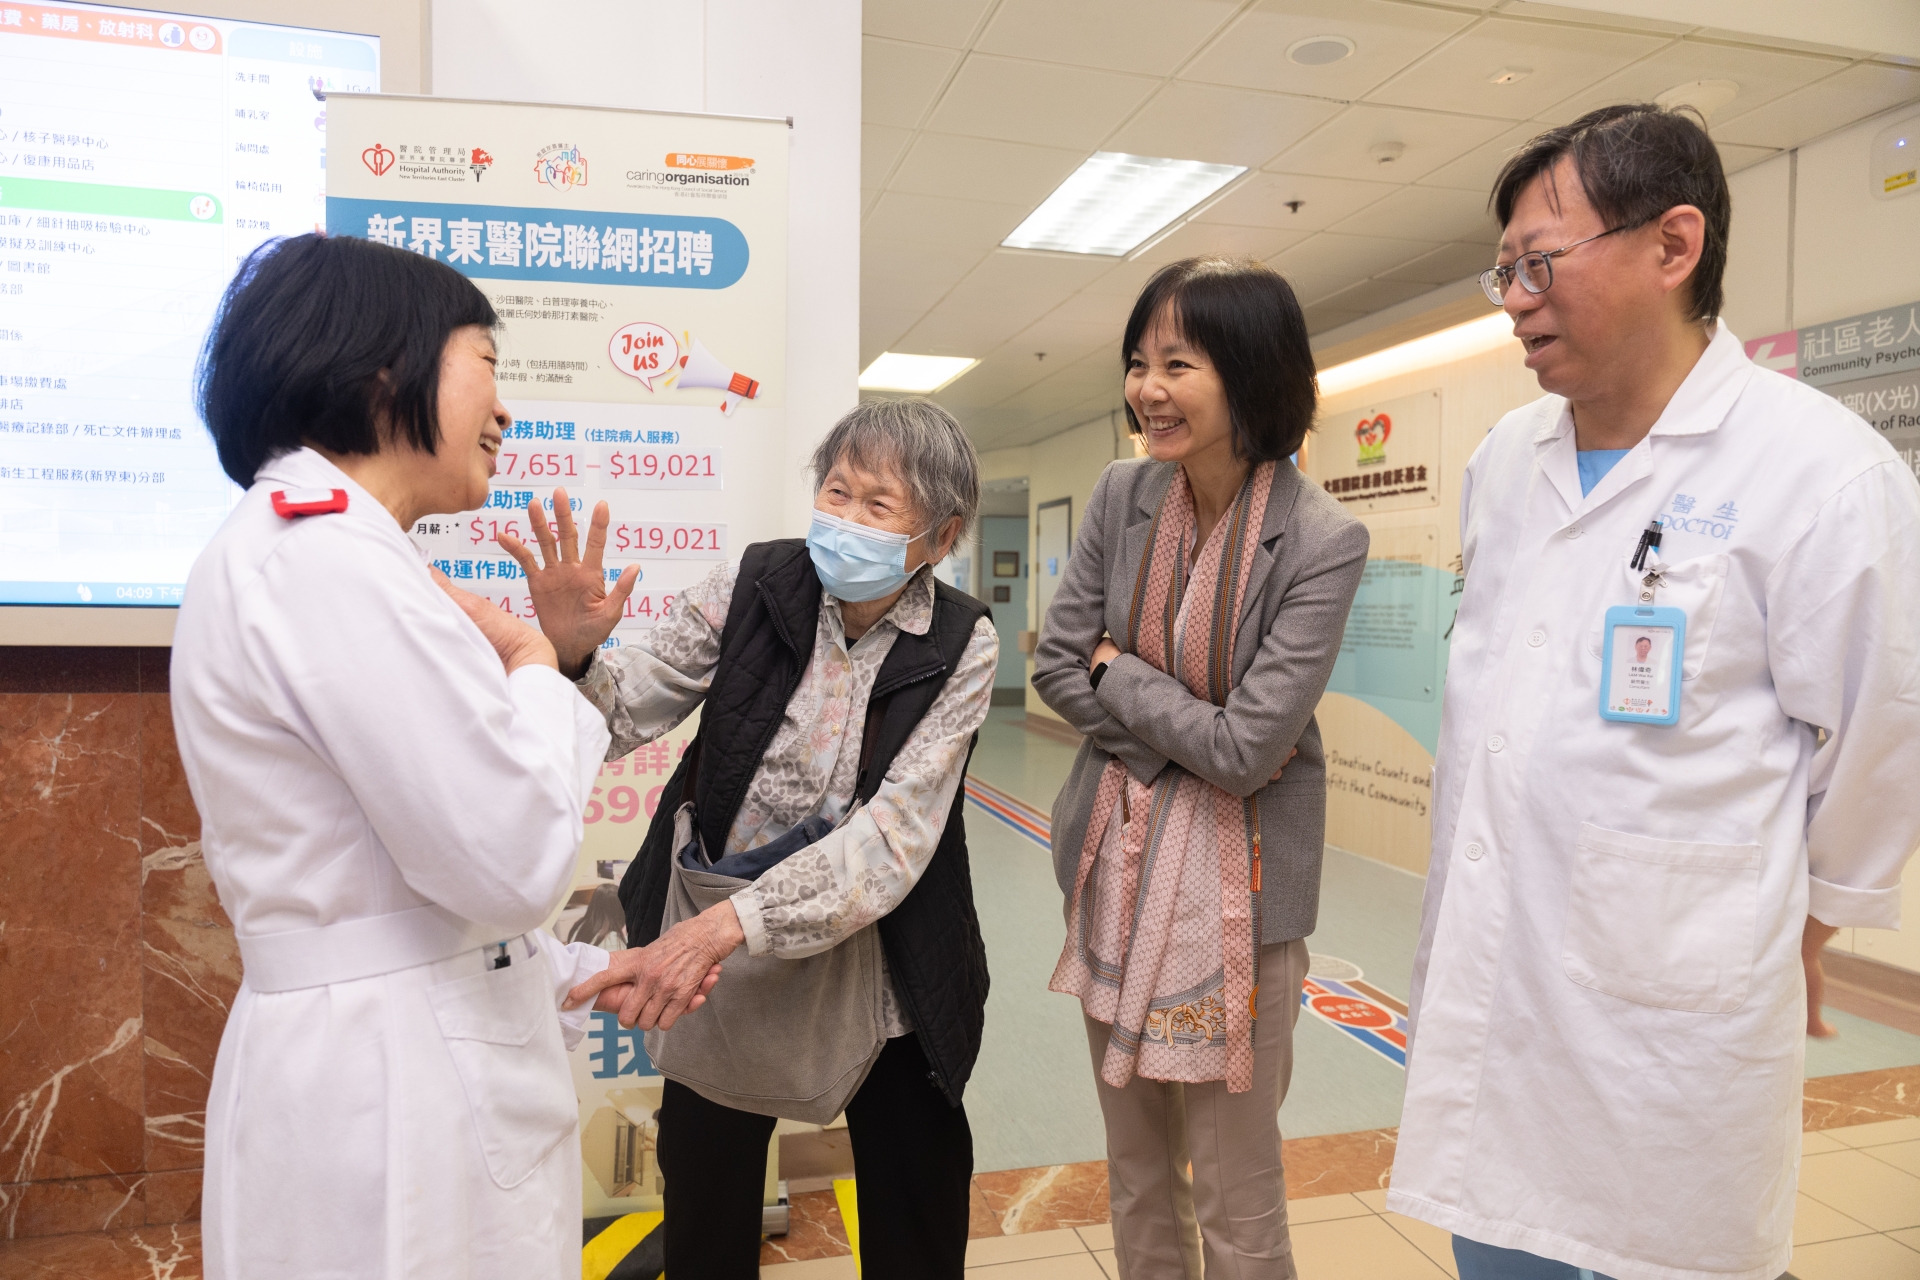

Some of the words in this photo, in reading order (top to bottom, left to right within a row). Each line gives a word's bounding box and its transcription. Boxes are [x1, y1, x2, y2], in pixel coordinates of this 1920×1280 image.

[0, 9, 154, 40] 費、藥房、放射科
[235, 72, 270, 84] 洗手間
[235, 108, 270, 120] 哺乳室
[400, 144, 466, 156] 醫院管理局
[676, 154, 728, 169] 同心展關懷
[400, 165, 430, 175] Hospital
[431, 167, 466, 176] Authority
[235, 180, 282, 193] 輪椅借用
[367, 213, 714, 276] 新界東醫院聯網招聘
[622, 332, 664, 355] Join
[1803, 355, 1872, 378] Community
[1837, 385, 1919, 416] 部(X光)
[1880, 415, 1895, 430] of
[610, 451, 716, 480] $19,021
[616, 524, 721, 553] $19,021
[116, 586, 153, 599] 04:09
[156, 586, 184, 600] 下午
[1332, 749, 1372, 772] Donation
[1374, 760, 1409, 783] Counts
[1412, 772, 1431, 788] and
[1350, 777, 1365, 797] the
[1367, 783, 1427, 816] Community
